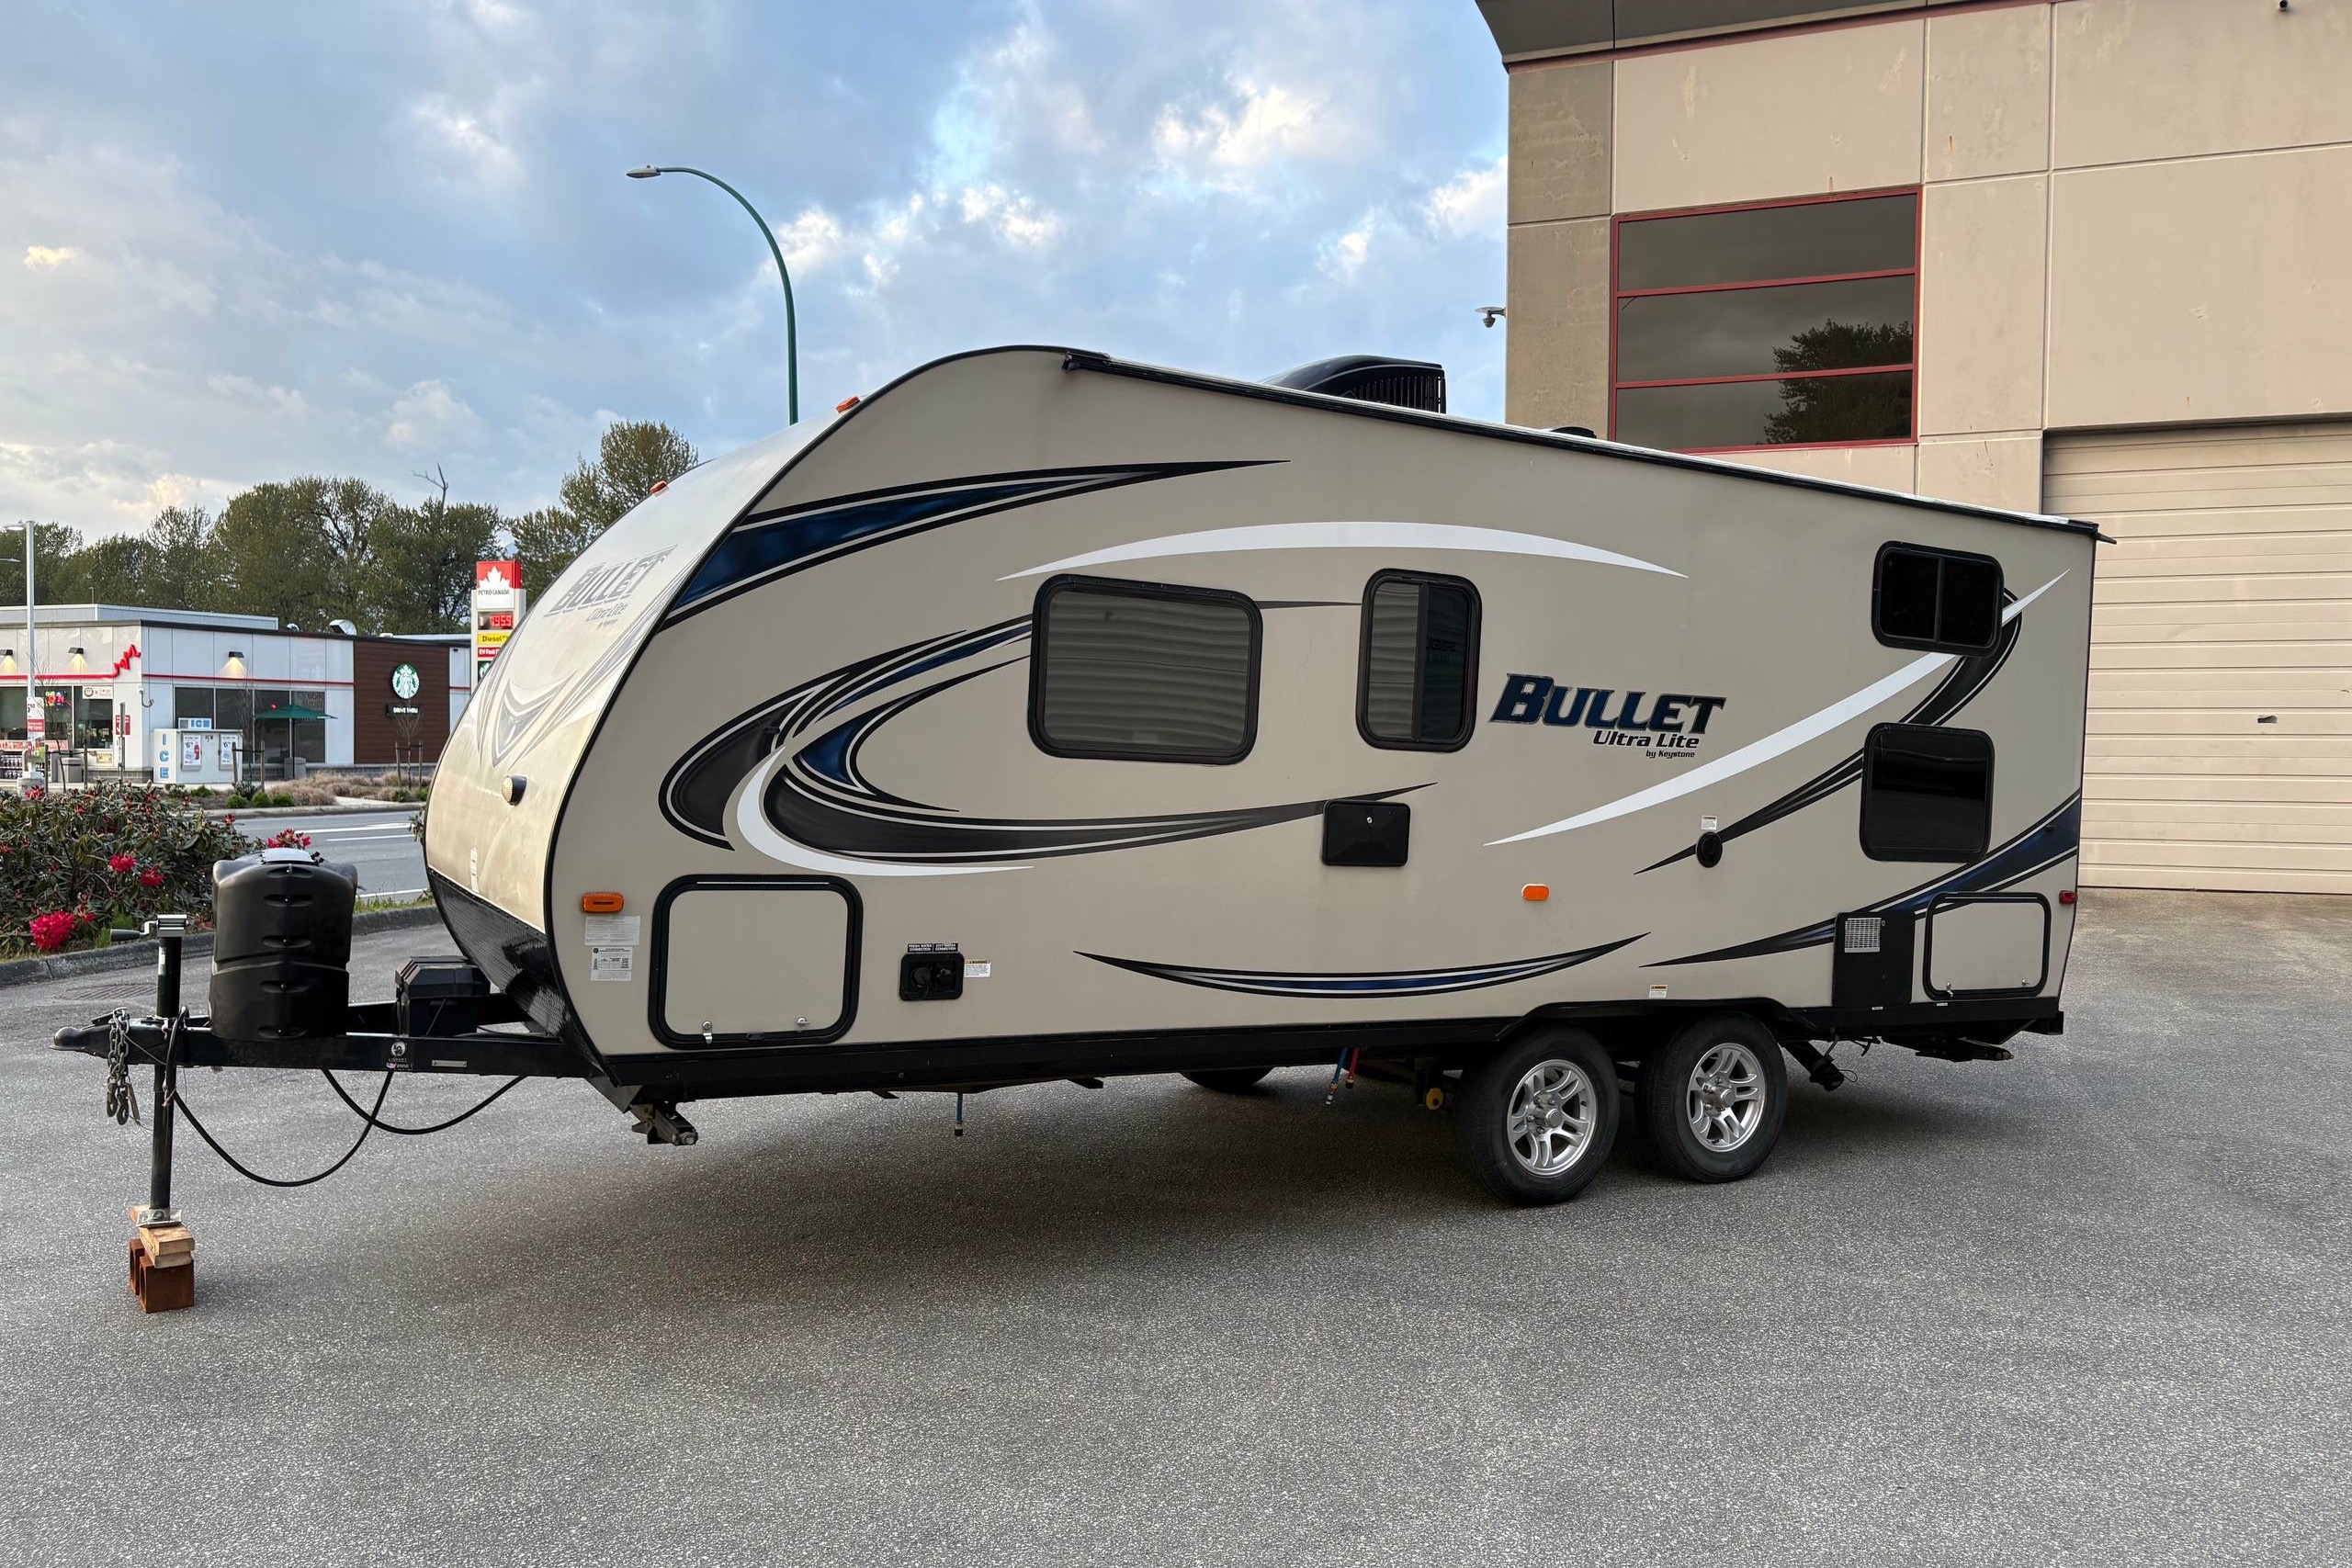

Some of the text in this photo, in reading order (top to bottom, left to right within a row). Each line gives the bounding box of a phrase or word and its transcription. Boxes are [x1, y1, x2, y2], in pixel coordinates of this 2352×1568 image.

[543, 544, 678, 618] BULLET
[1488, 672, 1727, 735] BULLET
[190, 719, 210, 728] ICE
[1593, 730, 1700, 749] Ultra Lite
[1645, 750, 1696, 760] by Keystone
